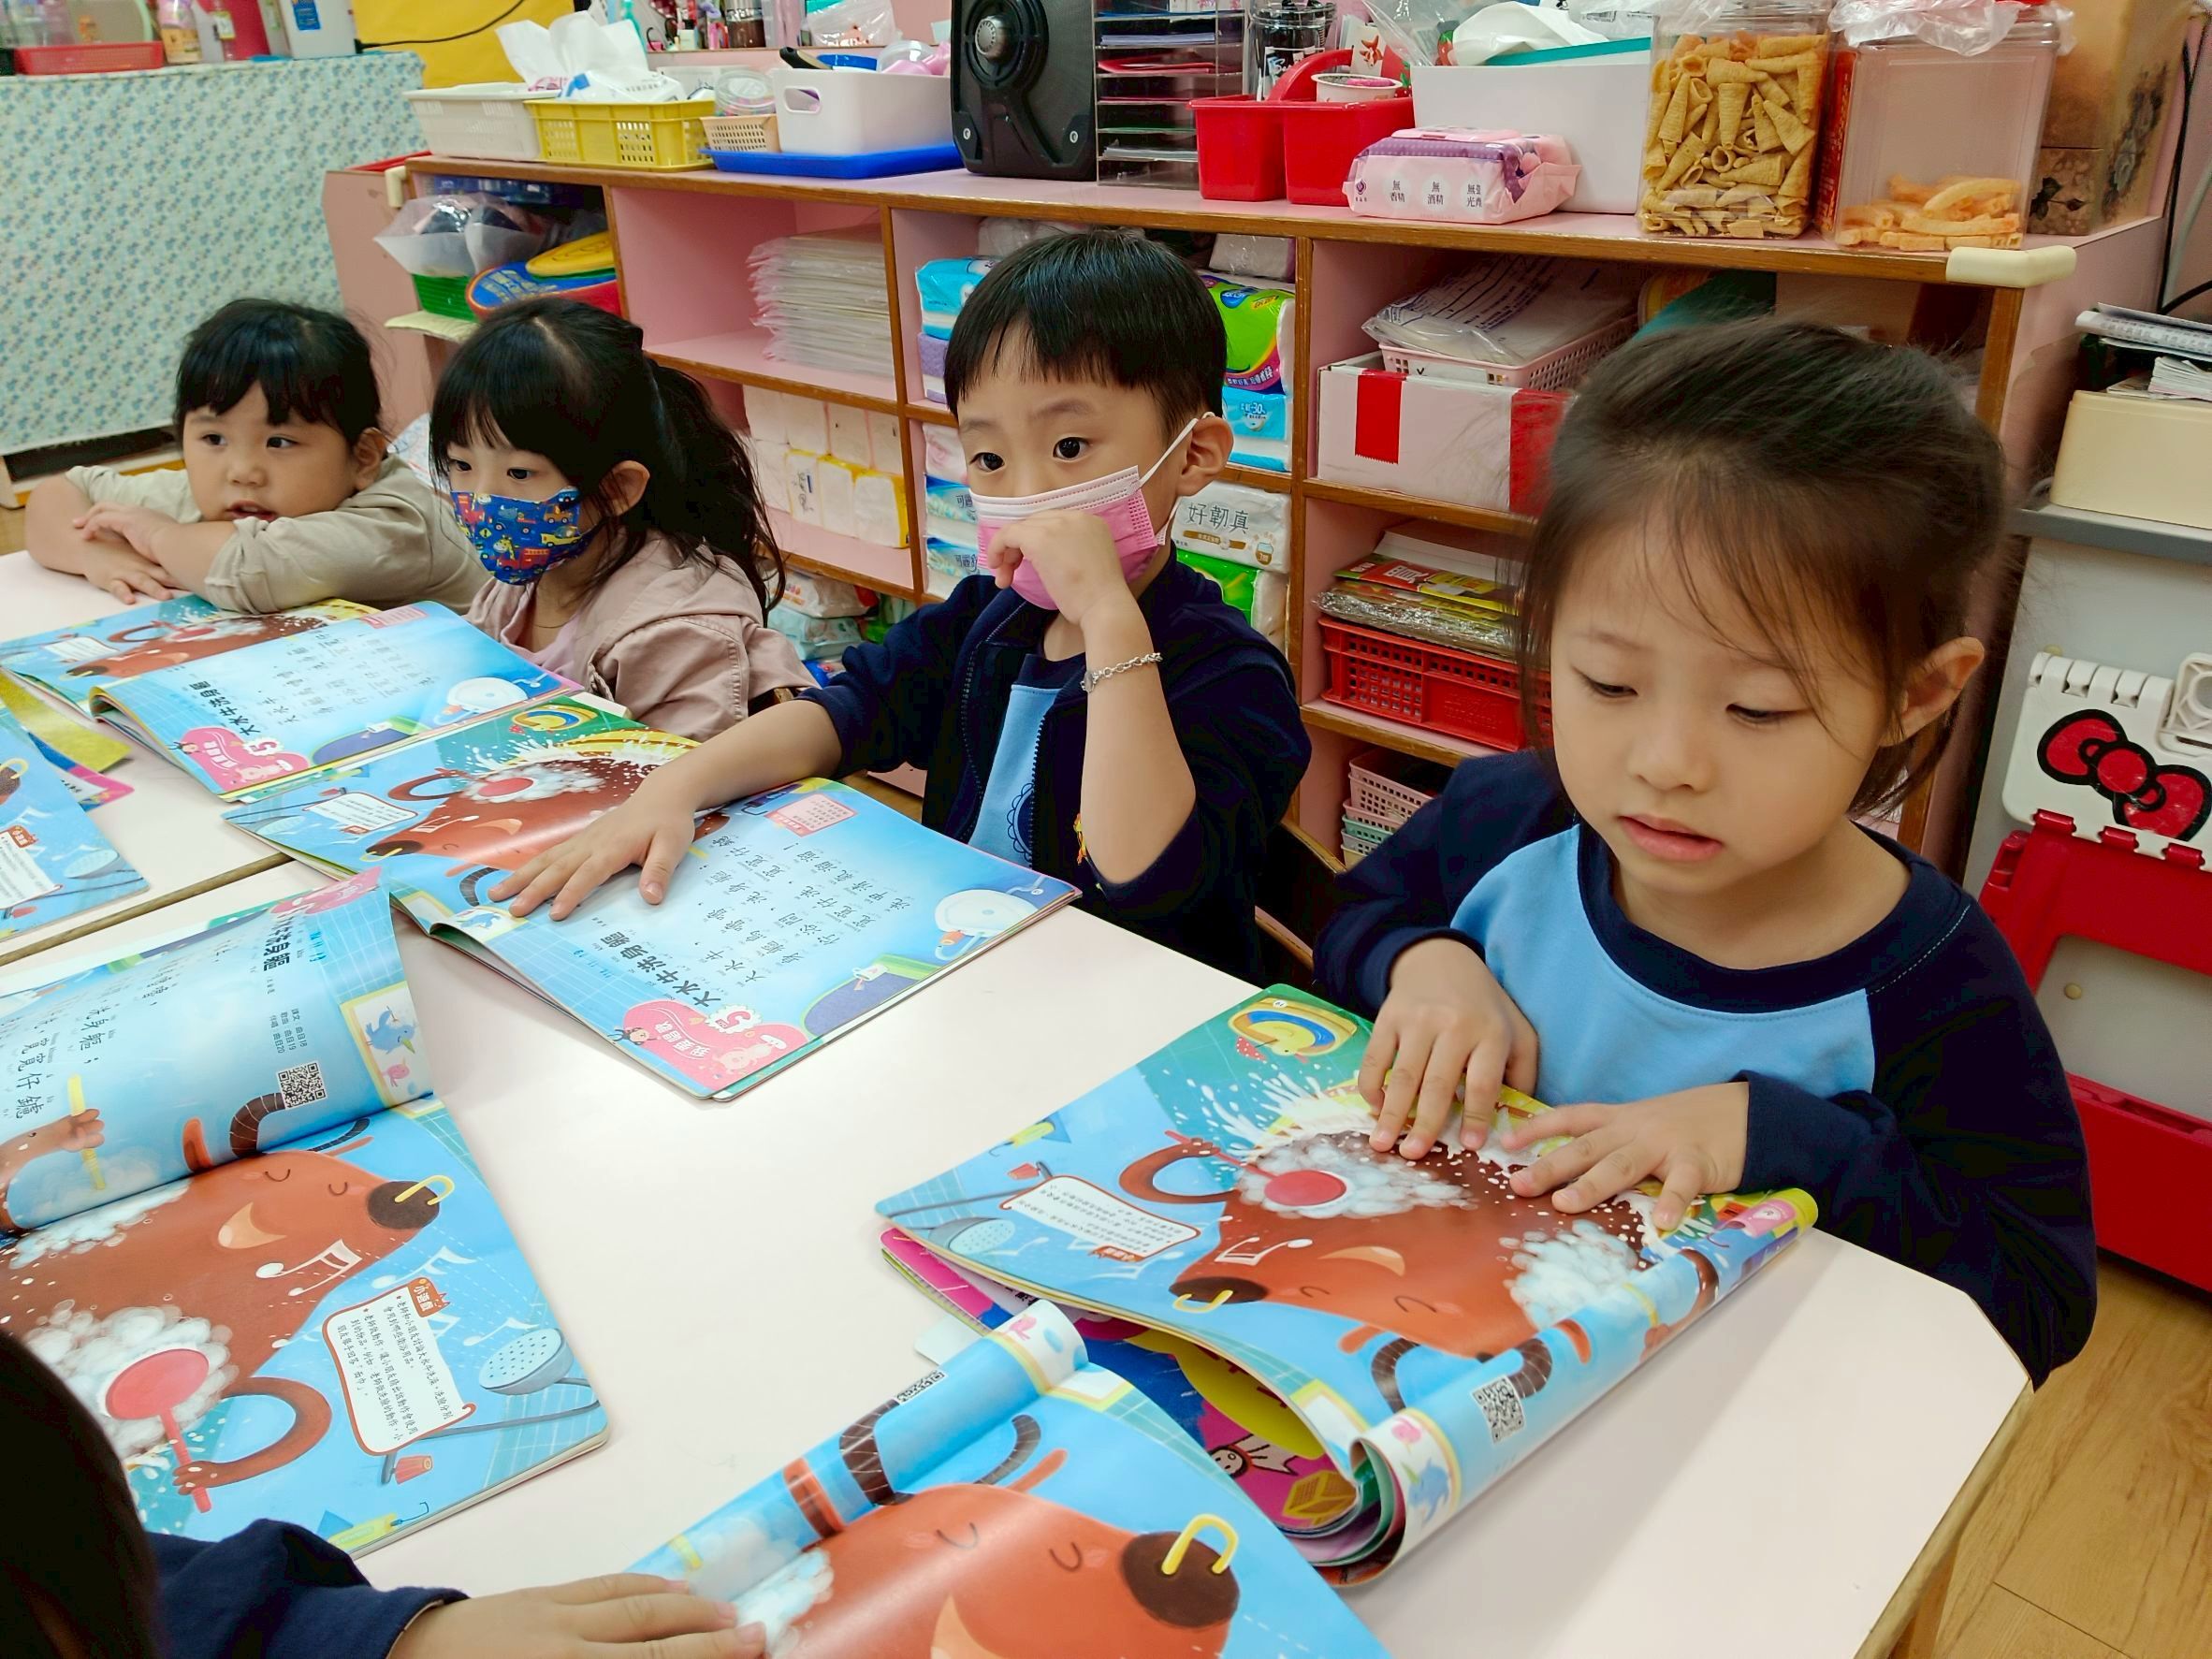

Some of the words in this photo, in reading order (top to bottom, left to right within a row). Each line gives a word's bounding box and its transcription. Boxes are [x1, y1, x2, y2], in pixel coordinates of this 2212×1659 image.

[1186, 502, 1249, 534] 好韌真
[250, 741, 277, 754] 5
[600, 931, 720, 1008] 大水牛洗身軀
[714, 1011, 749, 1030] 5
